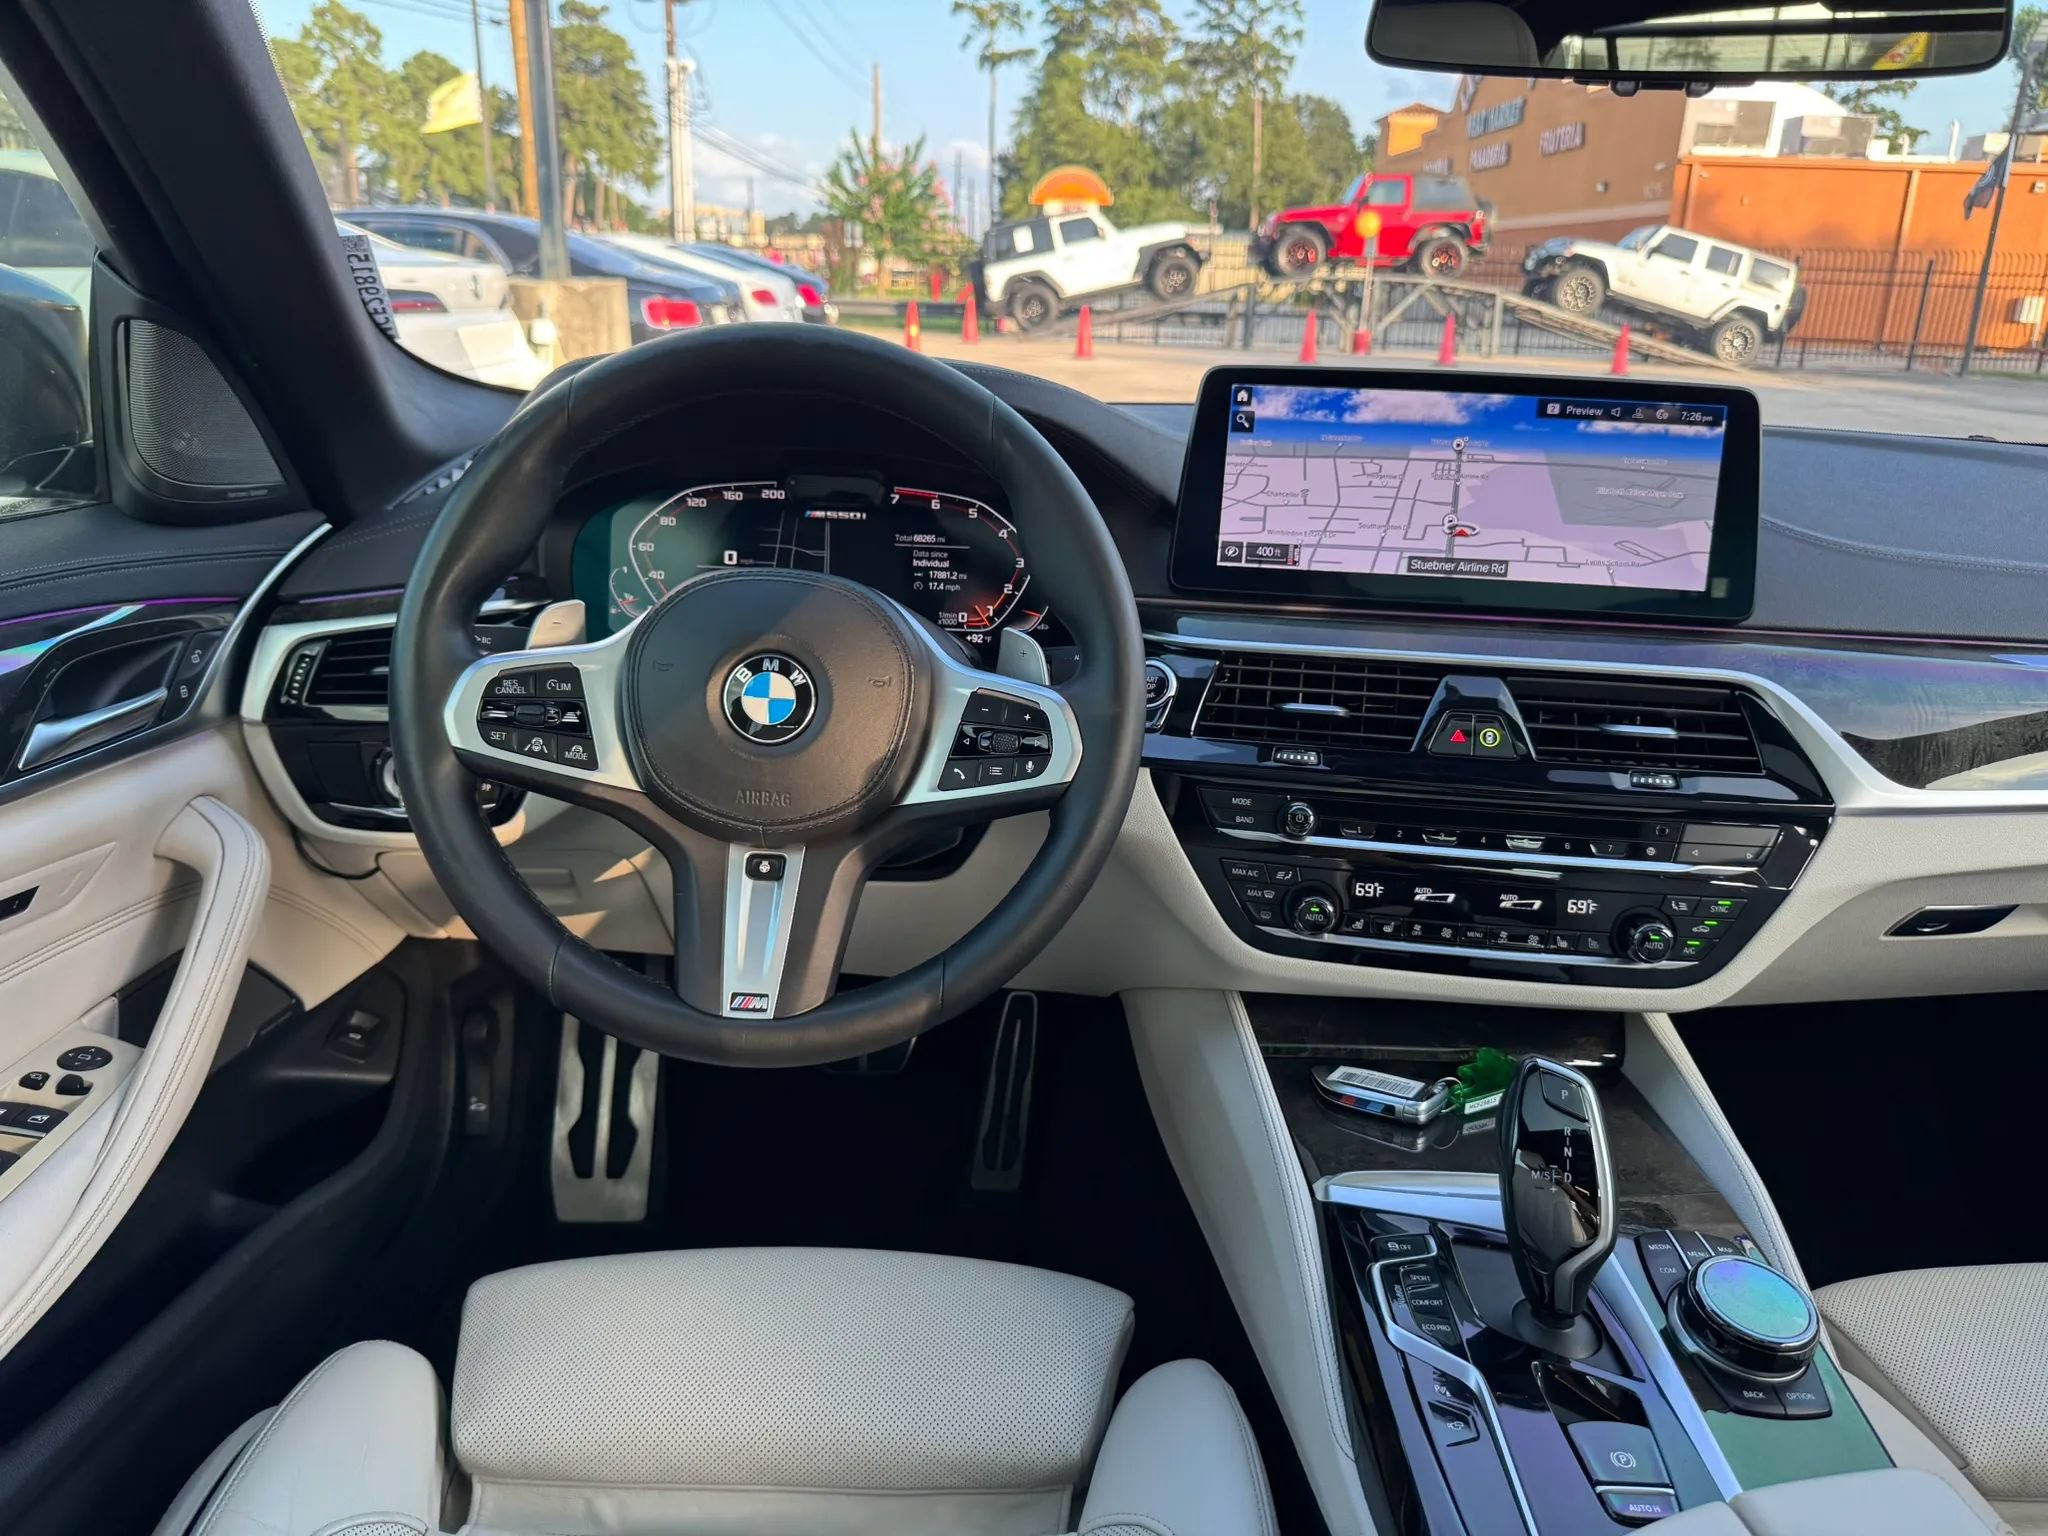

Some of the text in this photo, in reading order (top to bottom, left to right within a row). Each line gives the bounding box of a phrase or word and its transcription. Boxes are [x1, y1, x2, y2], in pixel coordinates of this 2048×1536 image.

[1566, 406, 1603, 417] Preview
[1680, 411, 1702, 422] 7:26
[722, 491, 743, 501] 160
[761, 490, 785, 500] 200
[890, 494, 900, 504] 7
[686, 498, 707, 508] 120
[931, 500, 941, 509] 6
[968, 508, 978, 518] 5
[660, 516, 676, 526] 80
[895, 534, 912, 542] Total
[913, 534, 936, 543] 68265
[998, 529, 1008, 539] 4
[638, 542, 654, 552] 60
[1256, 546, 1282, 558] 400 ft
[723, 550, 738, 565] 0
[913, 550, 929, 558] Data
[912, 559, 950, 568] Individual
[1015, 558, 1025, 568] 3
[1411, 559, 1505, 573] Stuebner Airline Rd
[648, 571, 664, 580] 40
[929, 570, 968, 580] 17881.2 mi
[928, 582, 961, 592] 17.4 mph
[1003, 584, 1013, 594] 2
[986, 606, 994, 617] 1
[938, 611, 968, 623] 1/min 0
[965, 634, 984, 643] +92
[735, 658, 807, 686] BMW
[503, 679, 519, 687] RES
[1146, 676, 1159, 684] ART
[495, 686, 527, 694] CANCEL
[556, 682, 572, 691] LIM
[490, 731, 507, 741] SET
[564, 751, 589, 761] MODE
[735, 788, 791, 807] AIRBAG
[1232, 797, 1252, 805] MODE
[1236, 816, 1254, 824] BAND
[1396, 830, 1403, 838] 2
[1480, 836, 1487, 844] 4
[1564, 842, 1571, 850] 6
[1608, 844, 1613, 852] 7
[1232, 867, 1259, 878] MAX A/C
[1247, 888, 1262, 897] MAX
[1500, 893, 1519, 901] AUTO
[1305, 914, 1324, 922] AUTO
[1644, 942, 1664, 950] AUTO
[1561, 1089, 1569, 1100] P
[1563, 1126, 1572, 1137] R
[1563, 1147, 1572, 1158] N
[1531, 1170, 1551, 1181] M/S
[1564, 1172, 1572, 1183] D
[1648, 1243, 1672, 1251] MEDIA
[1742, 1390, 1766, 1399] BACK
[1786, 1392, 1815, 1400] OPTION
[1629, 1504, 1661, 1512] AUTO H
